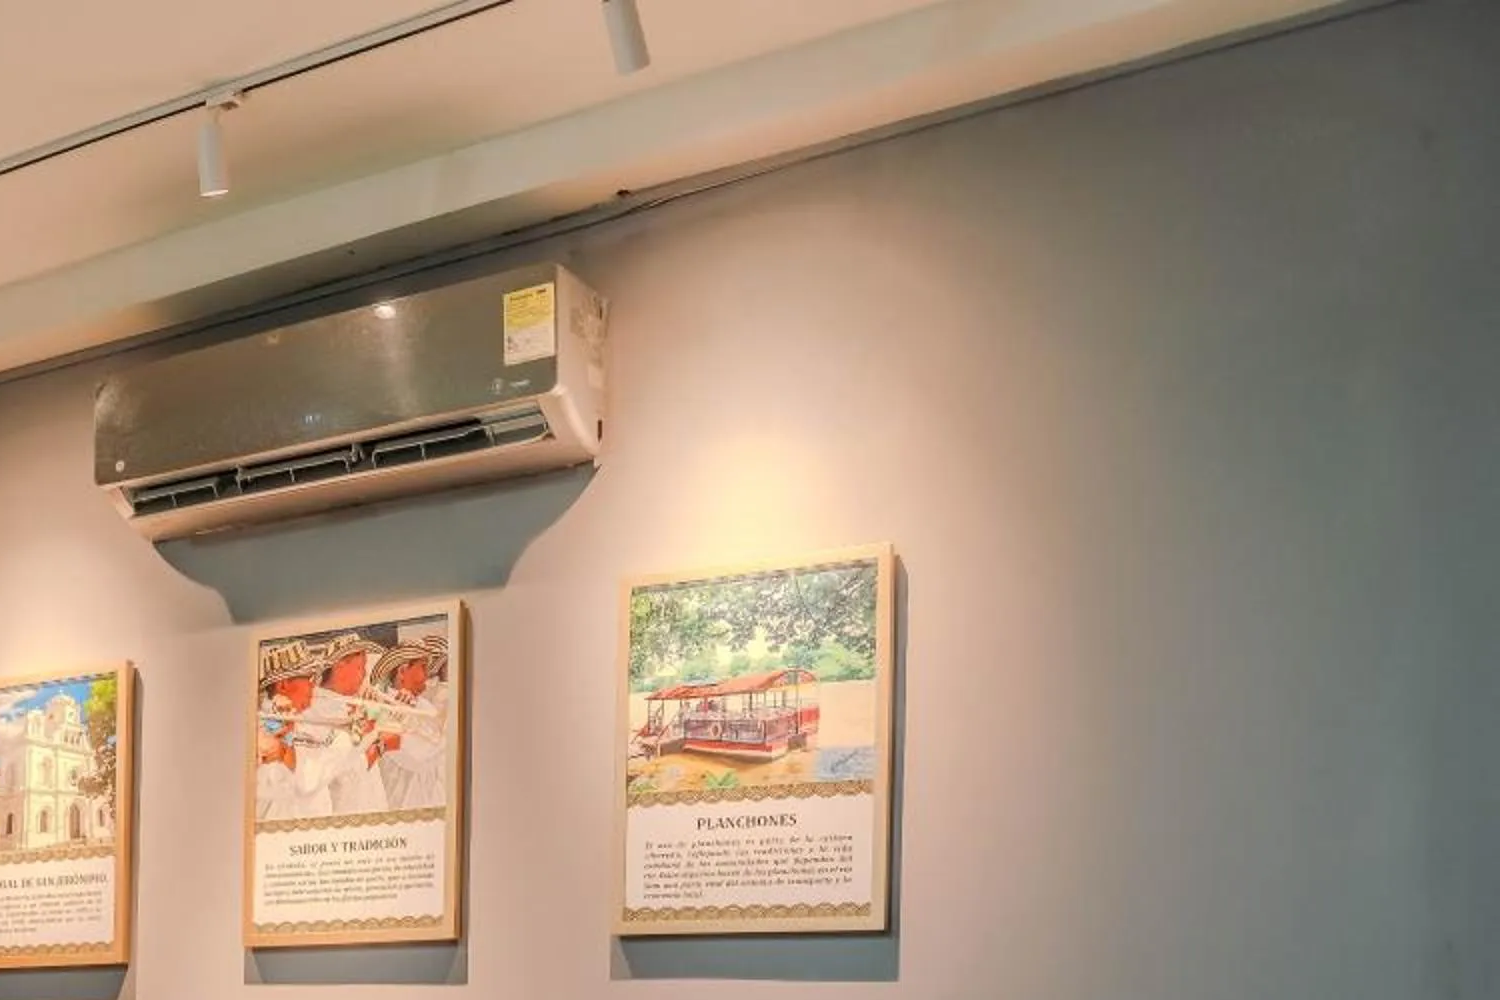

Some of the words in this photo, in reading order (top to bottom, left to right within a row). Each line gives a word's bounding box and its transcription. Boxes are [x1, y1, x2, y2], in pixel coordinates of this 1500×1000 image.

[696, 814, 797, 830] PLANCHONES
[289, 843, 327, 857] SABOR
[331, 842, 338, 853] Y
